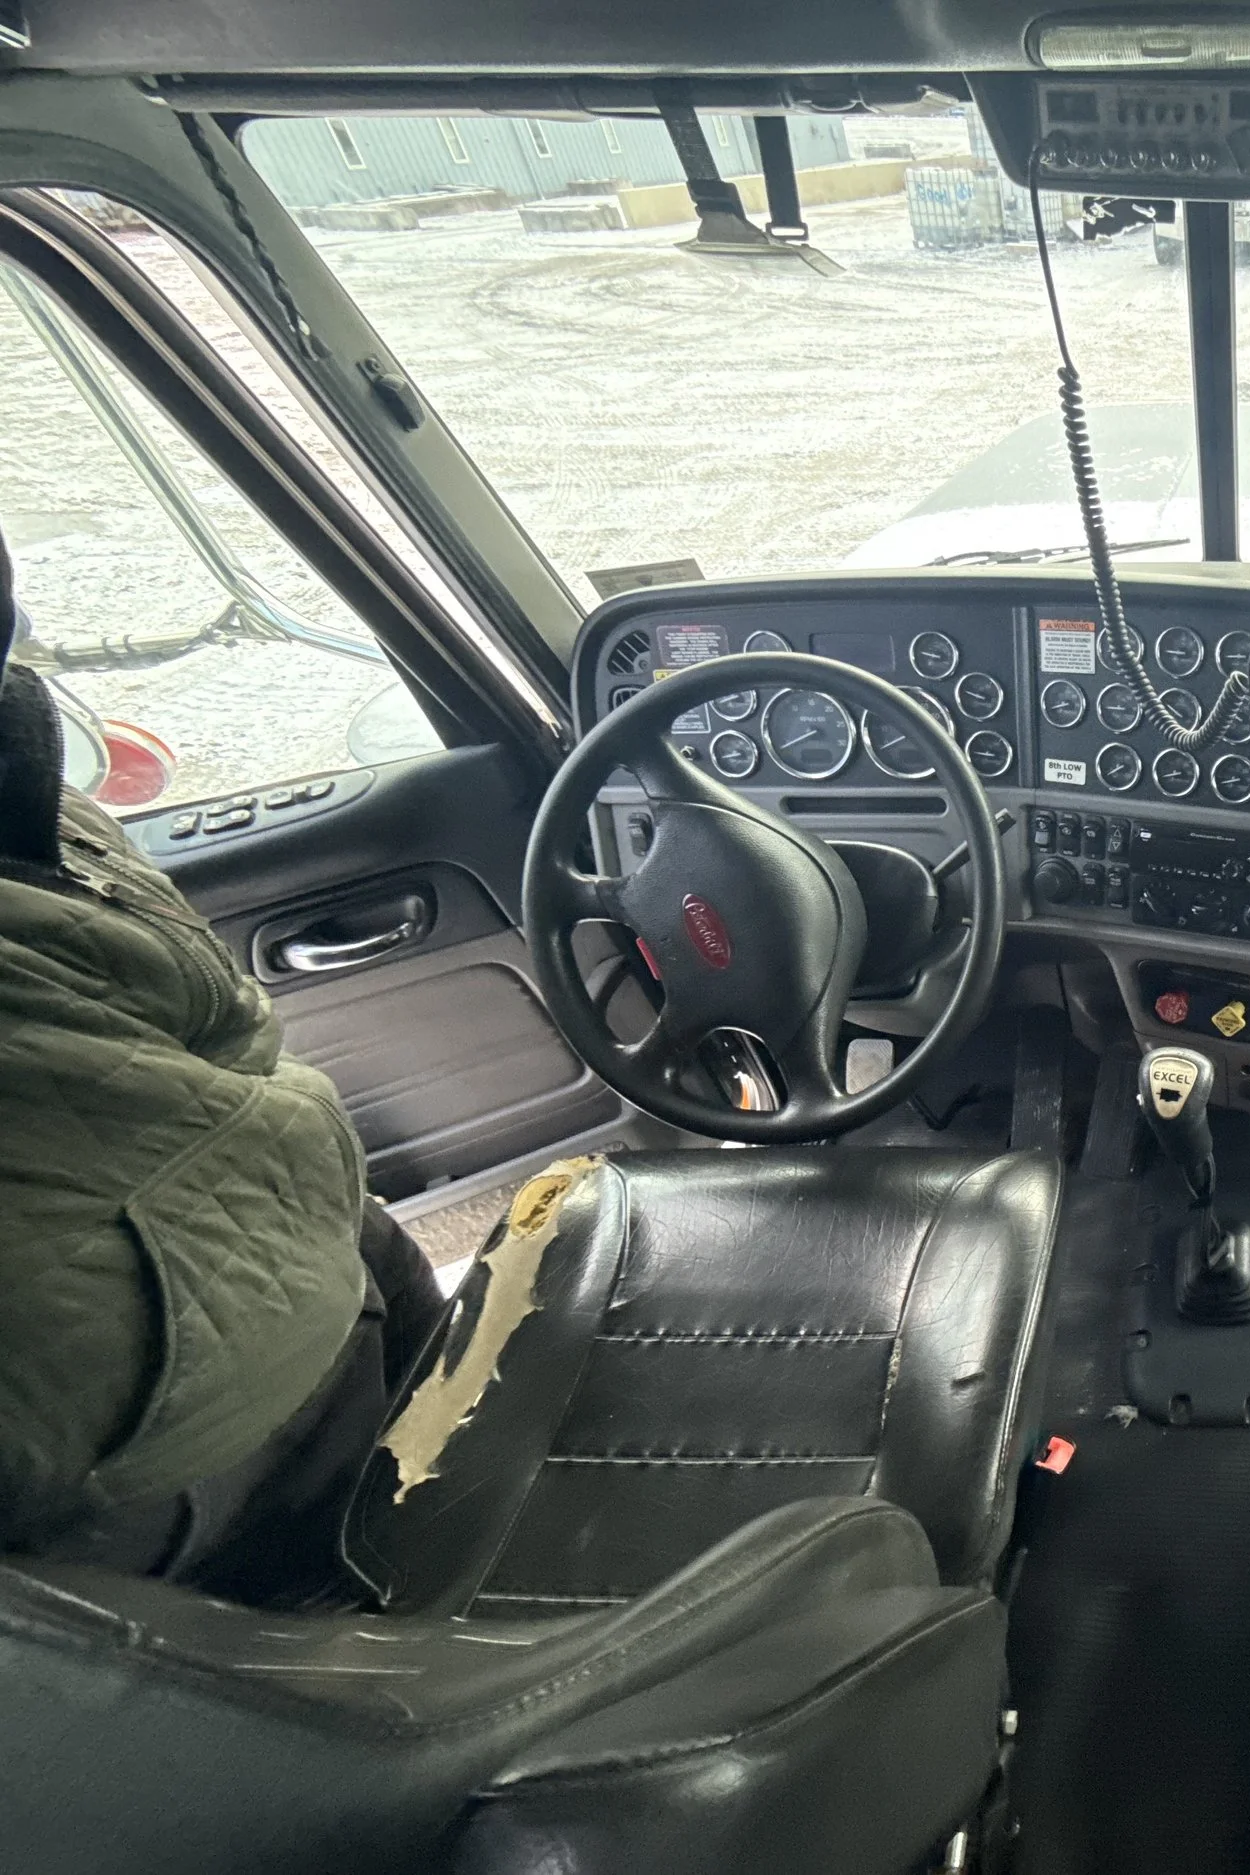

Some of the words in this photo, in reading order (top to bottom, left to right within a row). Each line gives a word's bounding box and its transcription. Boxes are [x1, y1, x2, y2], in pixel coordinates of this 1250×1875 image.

[1054, 621, 1090, 630] WARNING
[1048, 761, 1062, 769] 8th
[1063, 763, 1082, 772] LOW
[1057, 772, 1073, 780] PTO
[1153, 1070, 1191, 1085] EXCEL
